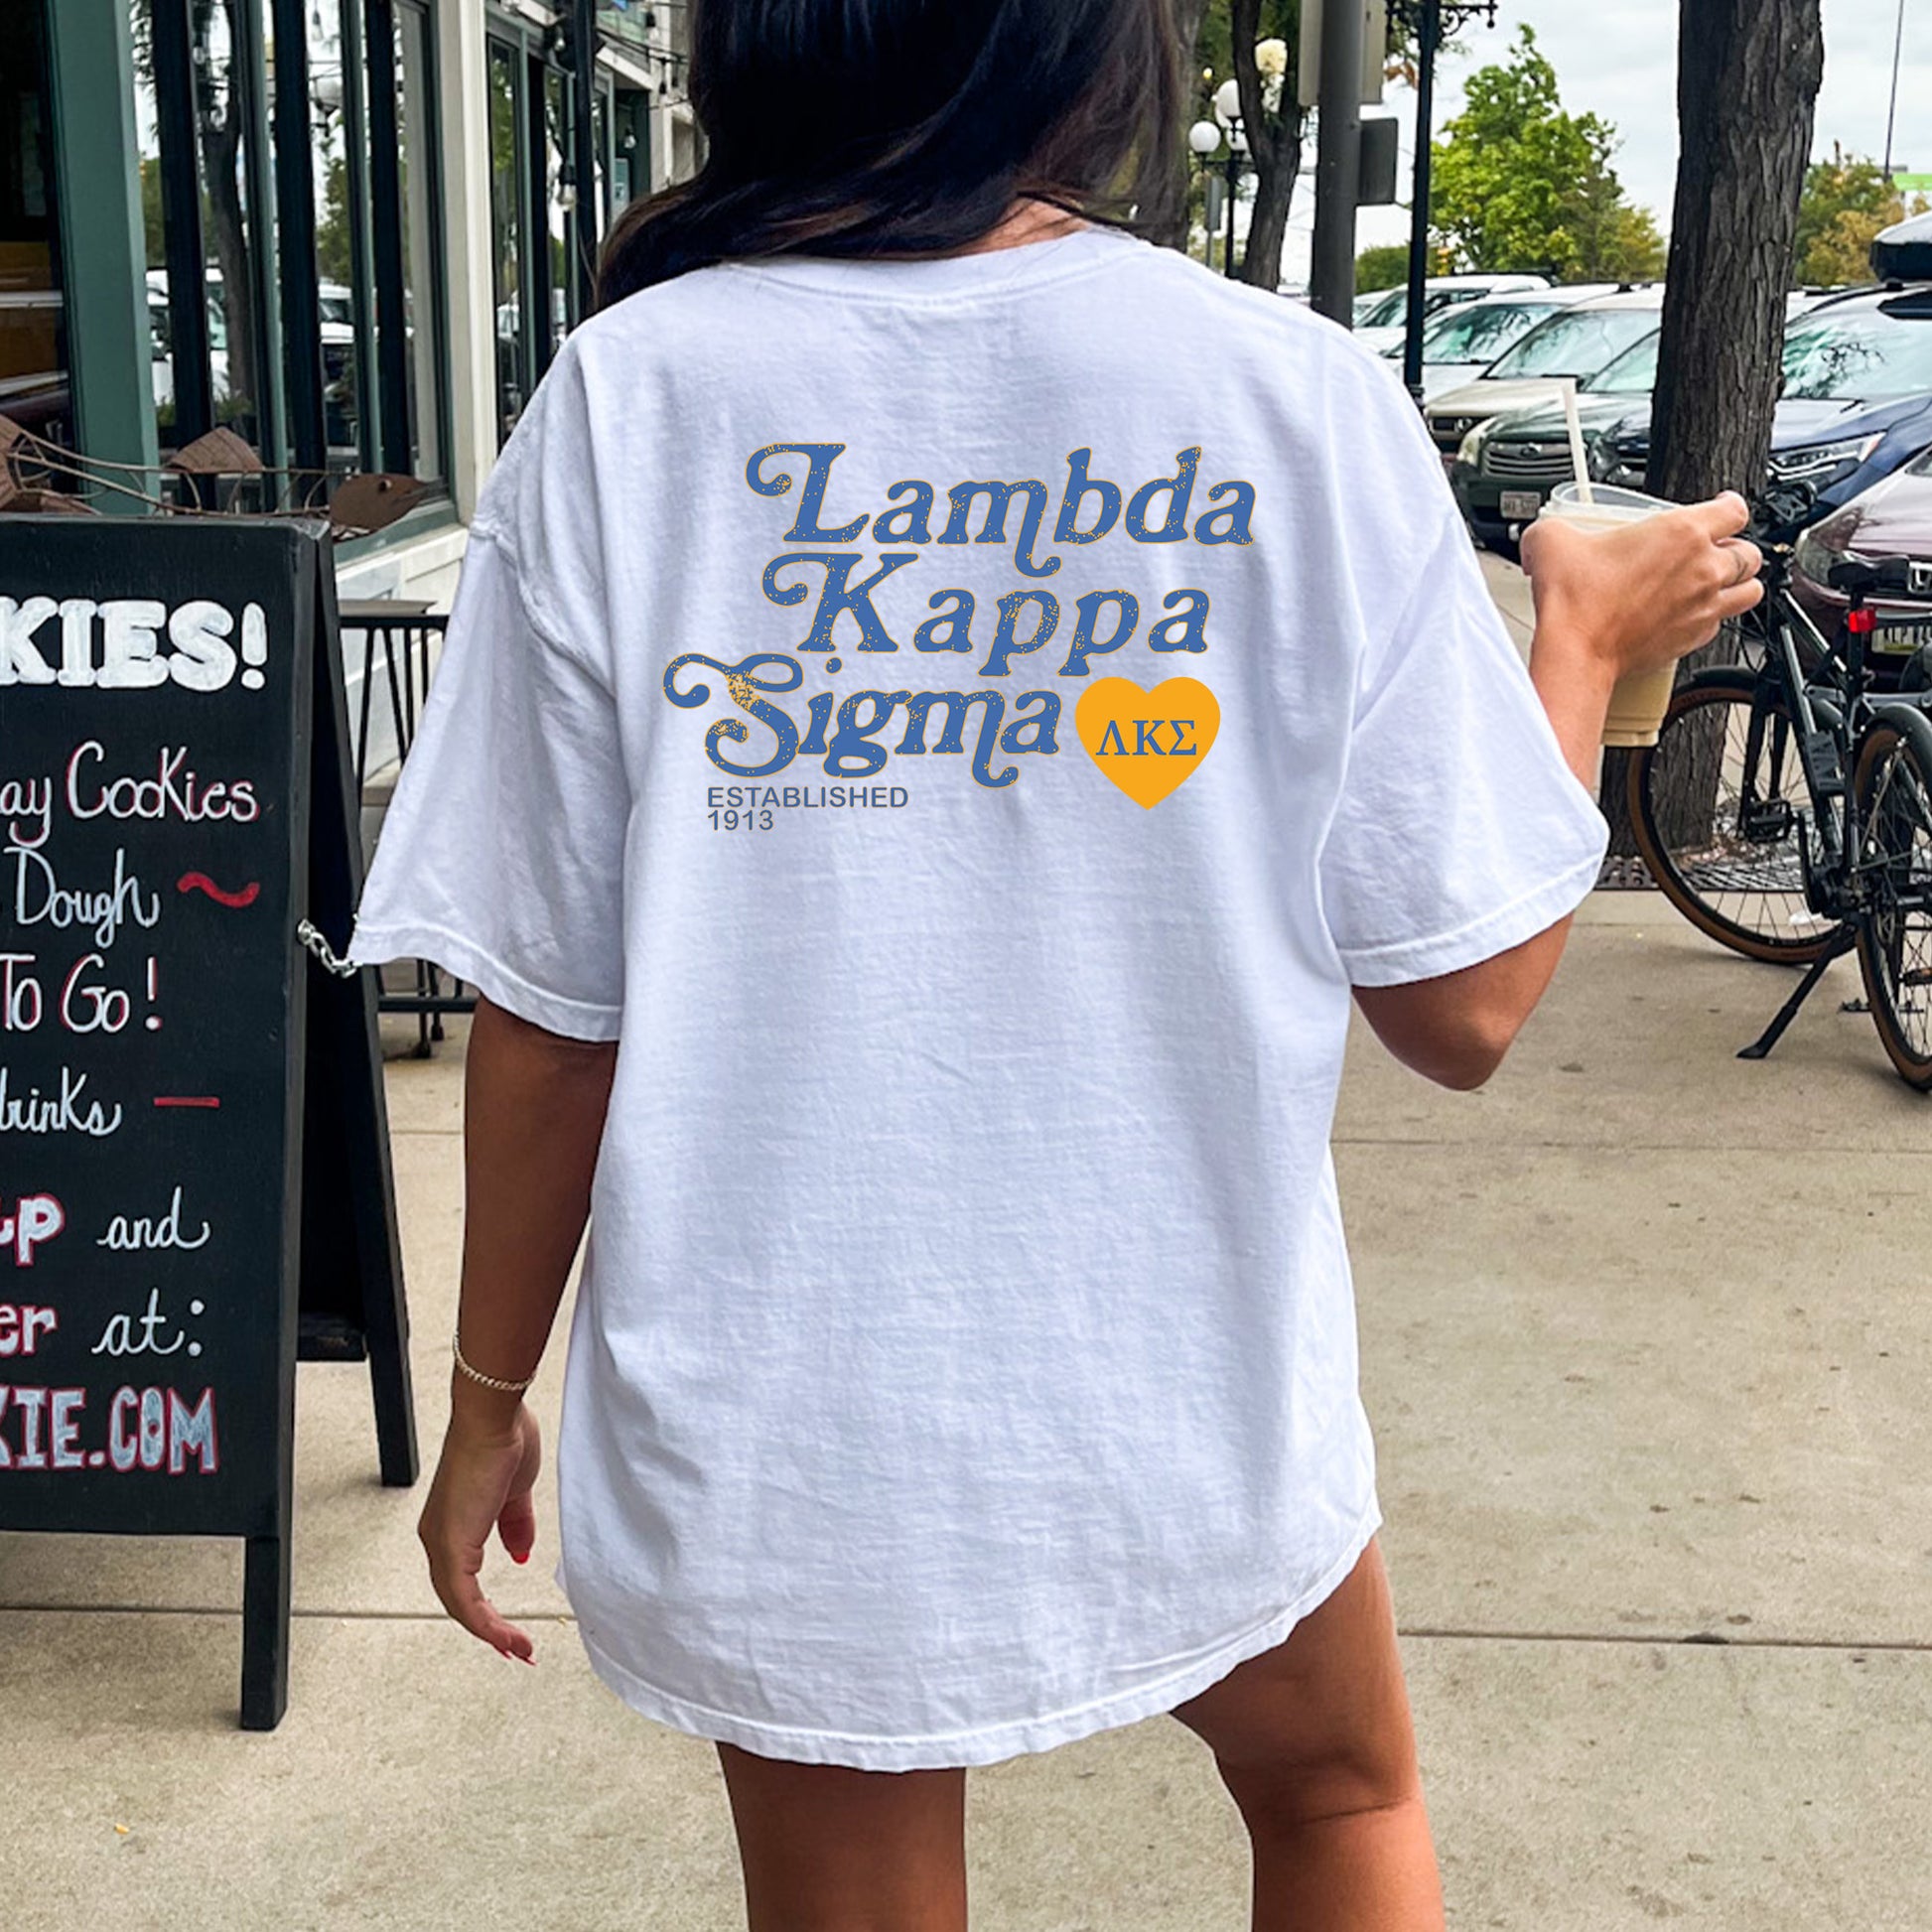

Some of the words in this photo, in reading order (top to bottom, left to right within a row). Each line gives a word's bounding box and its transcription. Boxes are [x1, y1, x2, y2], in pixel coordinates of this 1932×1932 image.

[745, 443, 1256, 578] Lambda
[761, 552, 1210, 677] Kappa
[663, 652, 1062, 788] Sigma
[707, 786, 908, 808] ESTABLISHED
[707, 809, 774, 831] 1913
[4, 846, 160, 949] Dough
[96, 1186, 210, 1250] and
